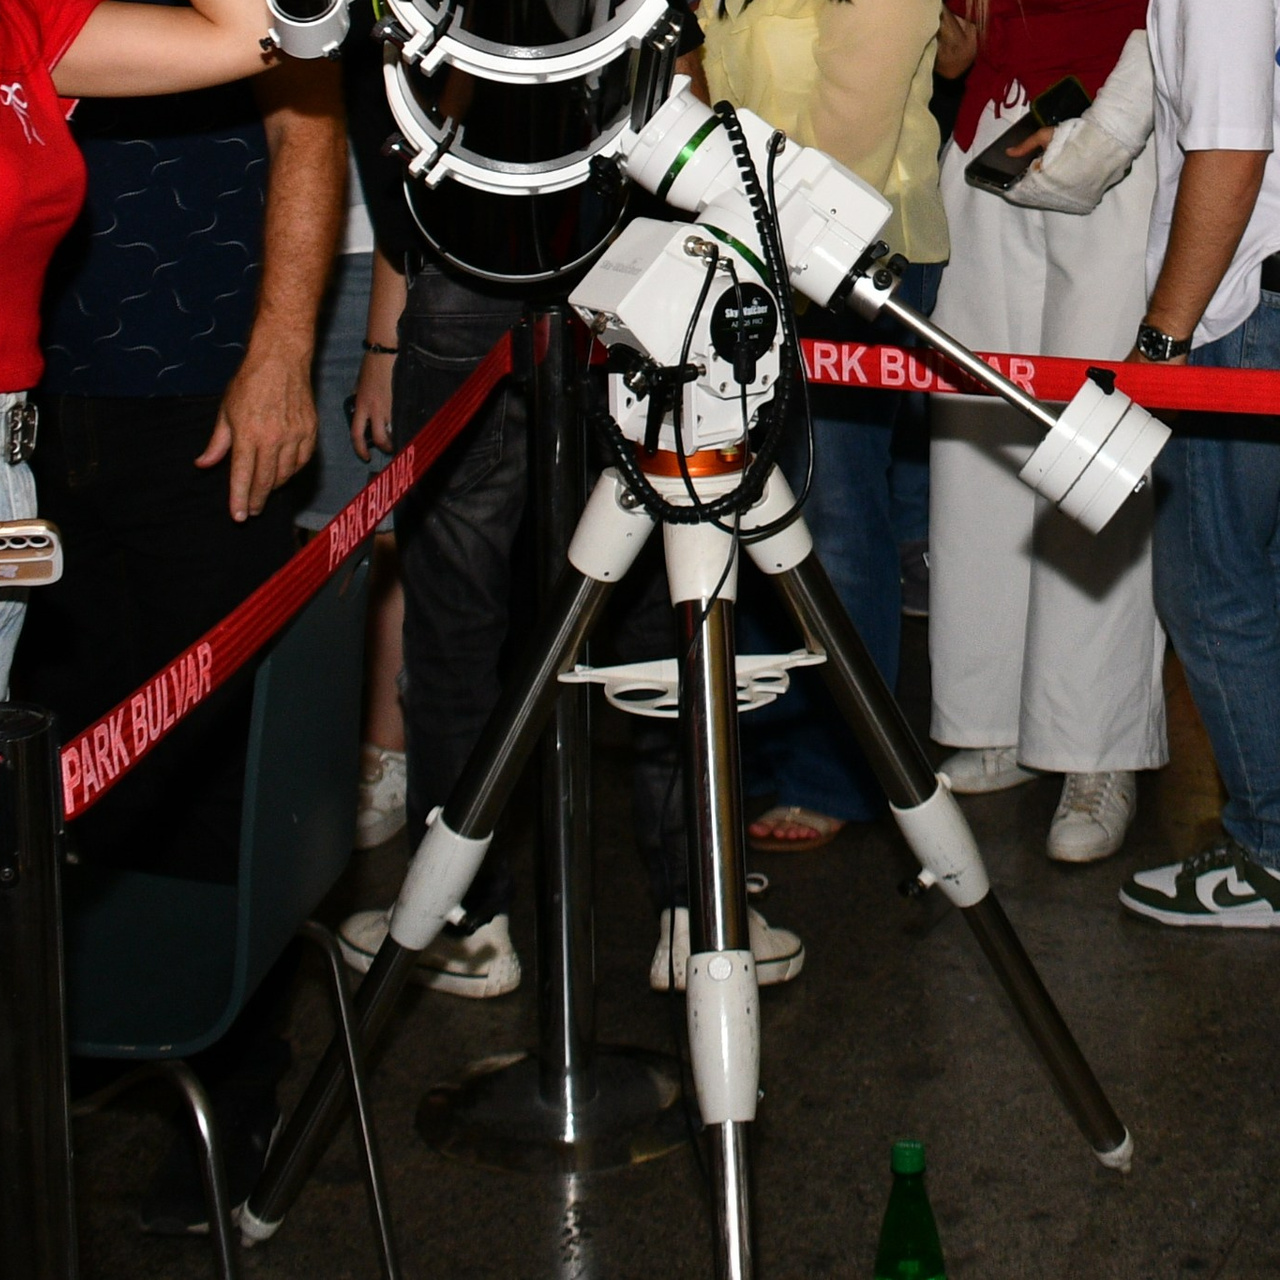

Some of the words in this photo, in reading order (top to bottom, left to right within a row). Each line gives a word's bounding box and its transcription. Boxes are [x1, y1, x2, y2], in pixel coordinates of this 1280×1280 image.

[328, 494, 365, 572] PARK
[366, 444, 416, 521] BULVAR
[61, 707, 131, 814] PARK
[131, 642, 214, 760] BULVAR
